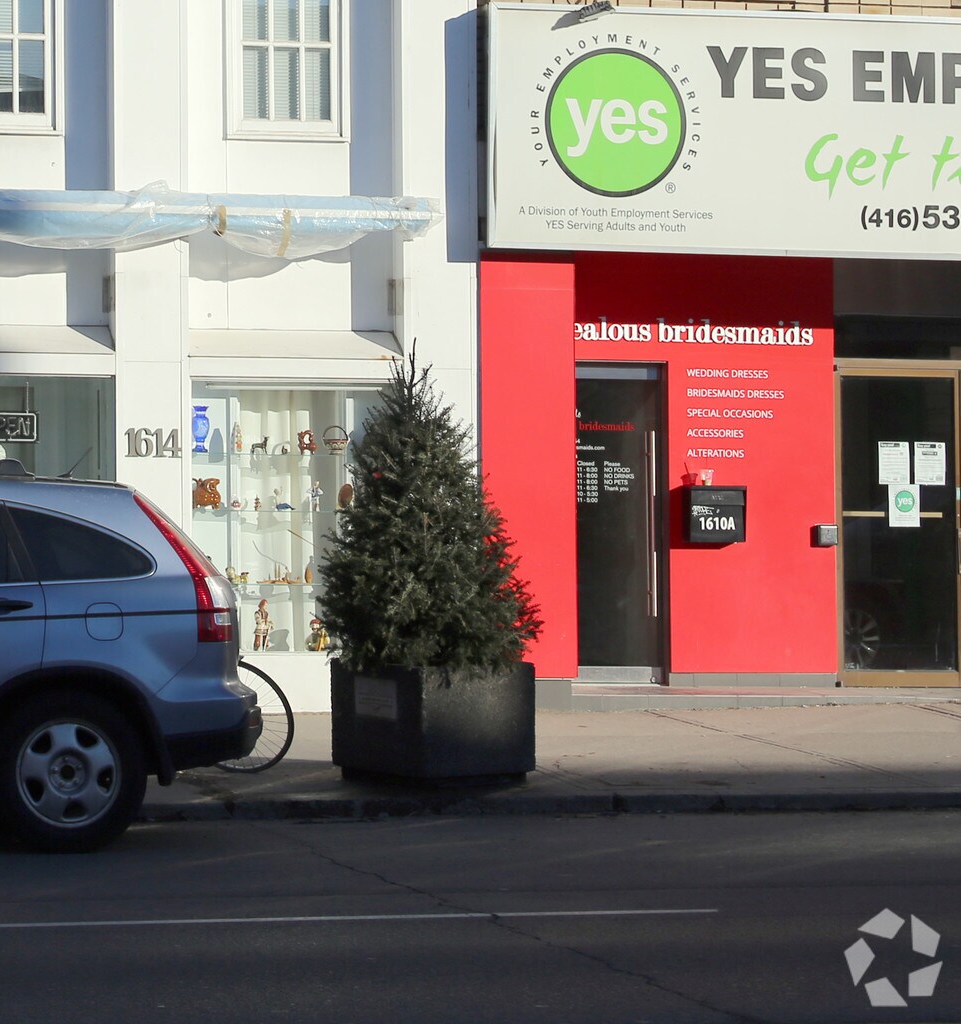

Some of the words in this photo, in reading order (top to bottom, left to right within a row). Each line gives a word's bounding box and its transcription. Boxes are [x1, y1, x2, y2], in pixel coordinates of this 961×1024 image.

[536, 34, 661, 93] EMPLOYMENT
[706, 45, 828, 102] YES
[852, 50, 961, 104] EMP
[671, 64, 701, 171] SERVICES
[565, 98, 668, 158] yes
[530, 110, 548, 166] YOUR
[804, 133, 911, 201] Get
[931, 135, 961, 193] t
[519, 206, 526, 215] A
[528, 206, 566, 216] Division
[569, 206, 579, 216] of
[581, 207, 608, 217] Youth
[611, 208, 670, 220] Employment
[672, 209, 714, 220] Services
[545, 220, 565, 230] YES
[567, 220, 604, 232] Serving
[606, 221, 636, 231] Adults
[638, 222, 657, 232] and
[659, 222, 687, 233] Youth
[656, 318, 814, 346] bridesmaids
[686, 368, 730, 378] WEDDING
[731, 369, 769, 379] DRESSES
[687, 388, 745, 398] BRIDESMAIDS
[747, 389, 785, 399] DRESSES
[686, 408, 722, 418] SPECIAL
[723, 409, 774, 419] OCCASIONS
[579, 420, 636, 432] bridesmaids
[686, 429, 744, 438] ACCESSORIES
[124, 427, 182, 458] 1614
[686, 449, 745, 458] ALTERATIONS
[897, 497, 912, 507] yes
[699, 516, 736, 530] 1610A
